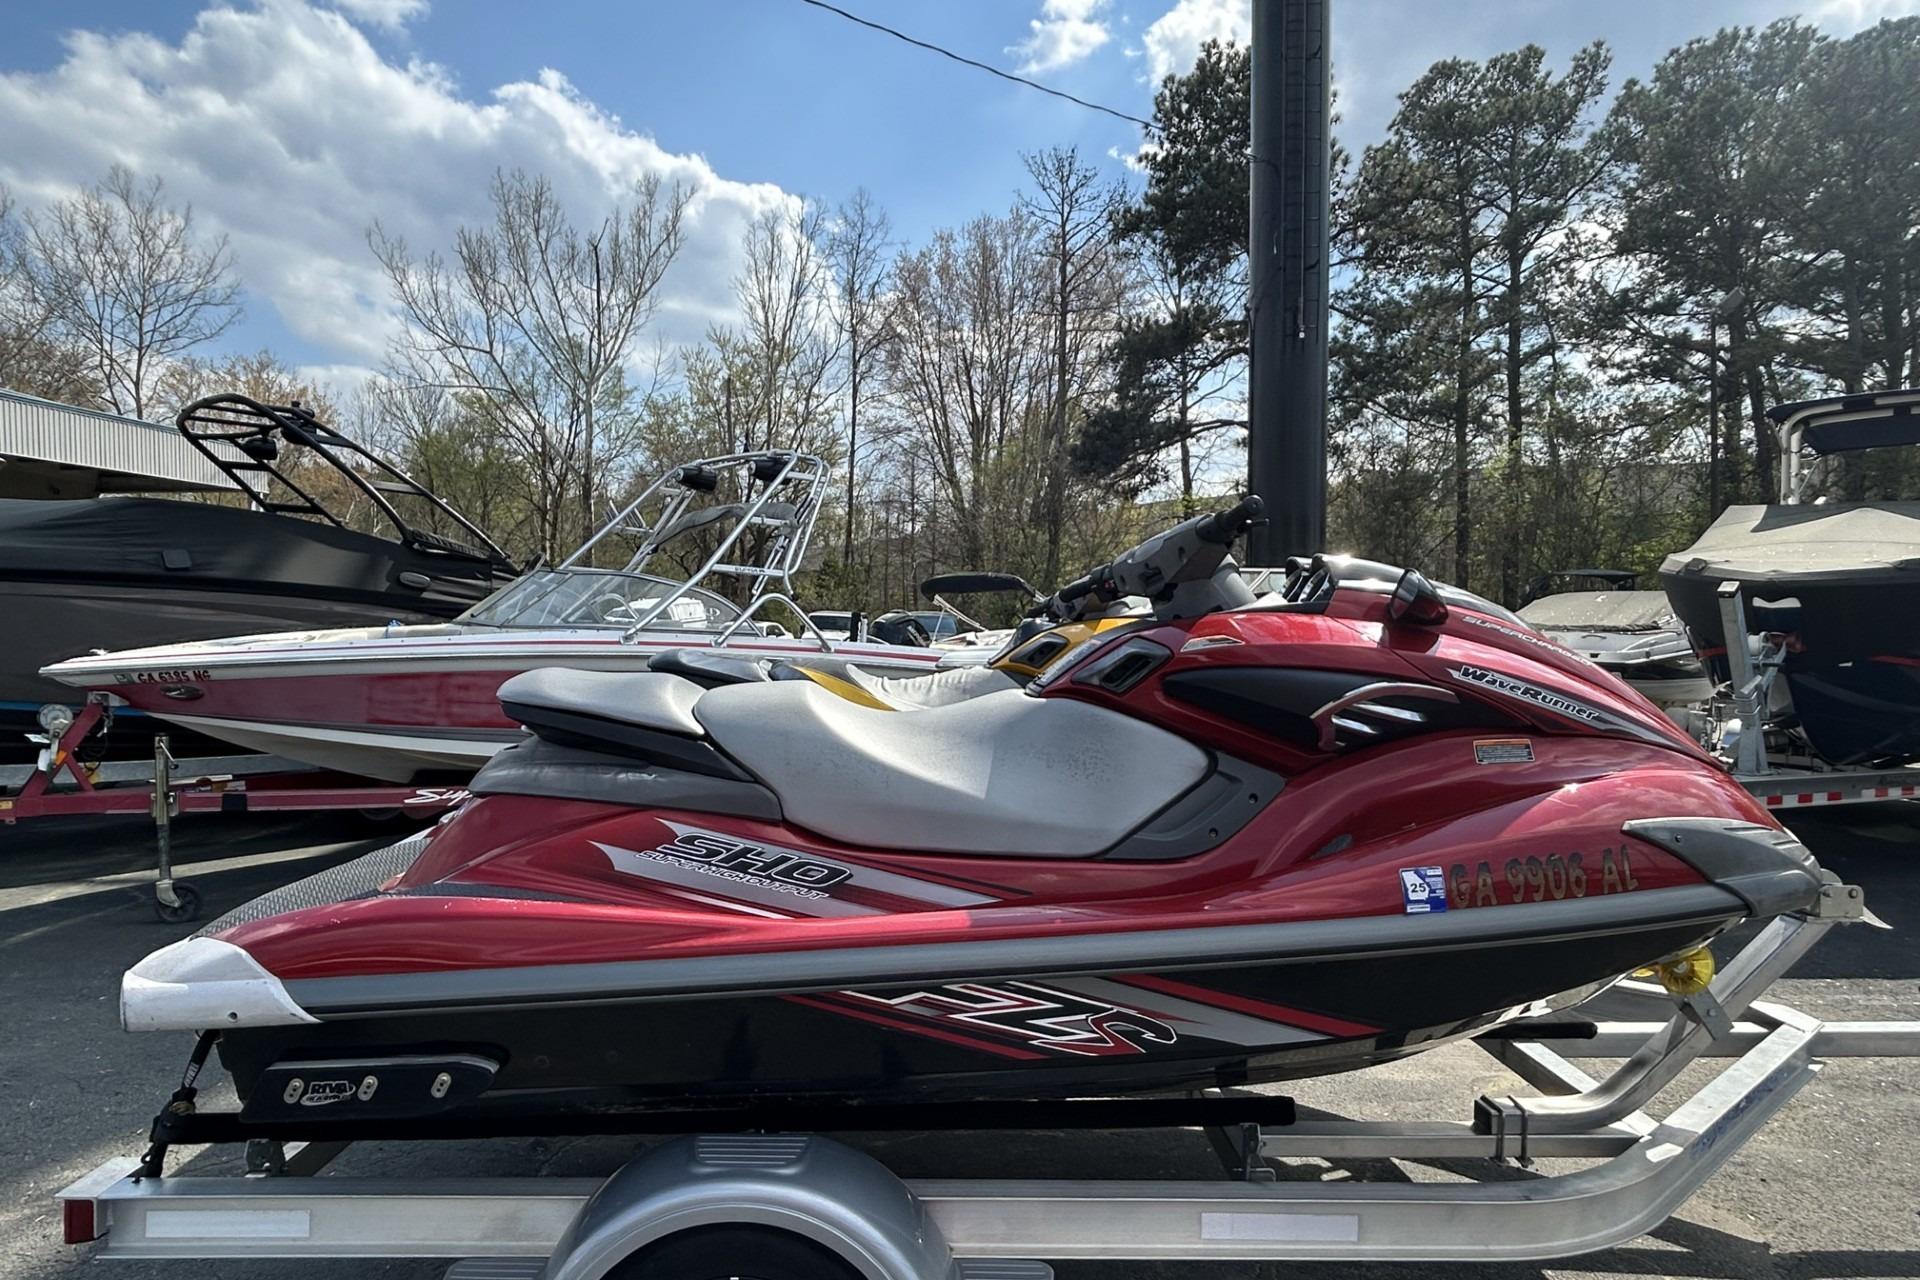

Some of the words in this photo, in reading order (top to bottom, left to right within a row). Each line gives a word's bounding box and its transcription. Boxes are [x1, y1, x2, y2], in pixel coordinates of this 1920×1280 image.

[1462, 615, 1594, 667] SUPERCHARGED
[137, 672, 157, 684] GA
[193, 669, 211, 682] NG
[1460, 665, 1599, 720] WaveRunner
[403, 788, 473, 807] Sup
[656, 833, 854, 888] SHO
[1450, 860, 1498, 909] GA
[1505, 852, 1588, 903] 9906
[1601, 844, 1640, 894] AL
[1410, 883, 1427, 893] 25
